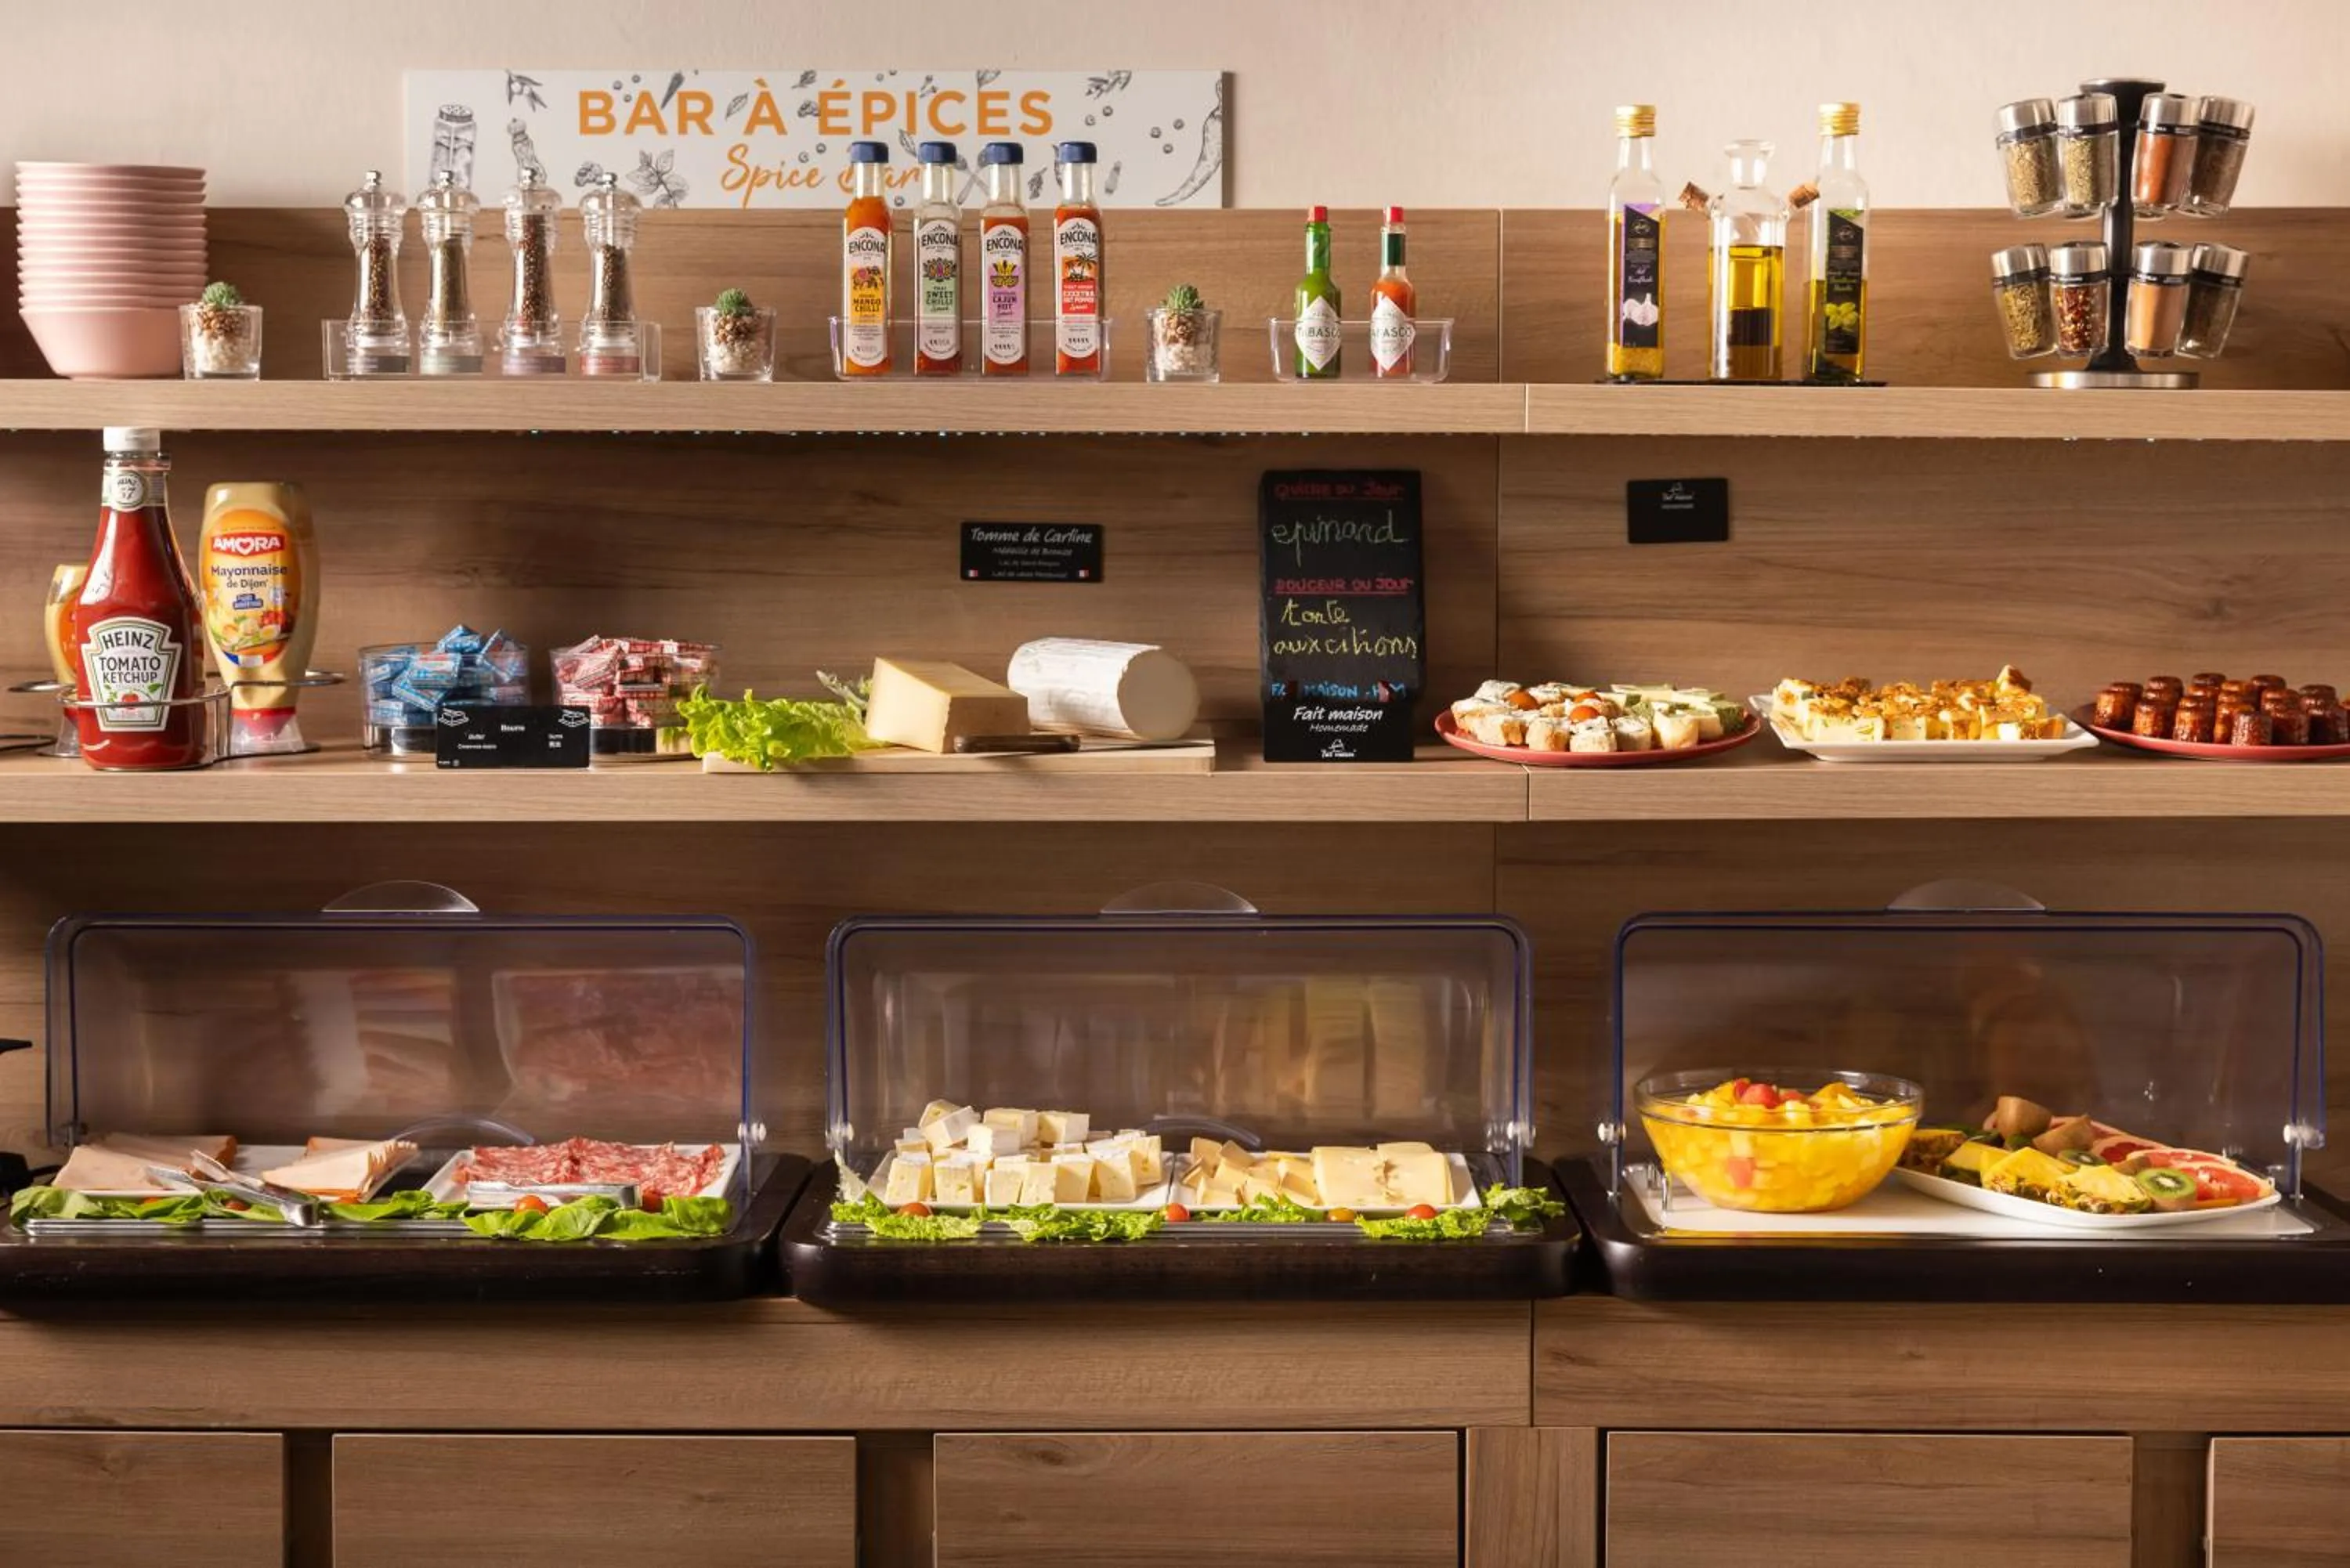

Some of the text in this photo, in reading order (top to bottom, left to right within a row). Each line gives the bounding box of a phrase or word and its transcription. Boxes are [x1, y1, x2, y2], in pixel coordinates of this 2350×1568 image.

[579, 78, 1054, 135] BAR À ÉPICES
[721, 143, 826, 208] Spice
[971, 526, 1020, 542] Tomme
[1023, 526, 1040, 543] de
[213, 537, 281, 555] AMORA
[211, 564, 287, 579] Mayonnaise
[226, 580, 238, 588] de
[102, 630, 155, 649] HEINZ
[99, 656, 161, 671] TOMATO
[103, 671, 157, 684] KETCHUP
[1293, 706, 1383, 721] Fait maison
[1309, 723, 1368, 733] Homemade
